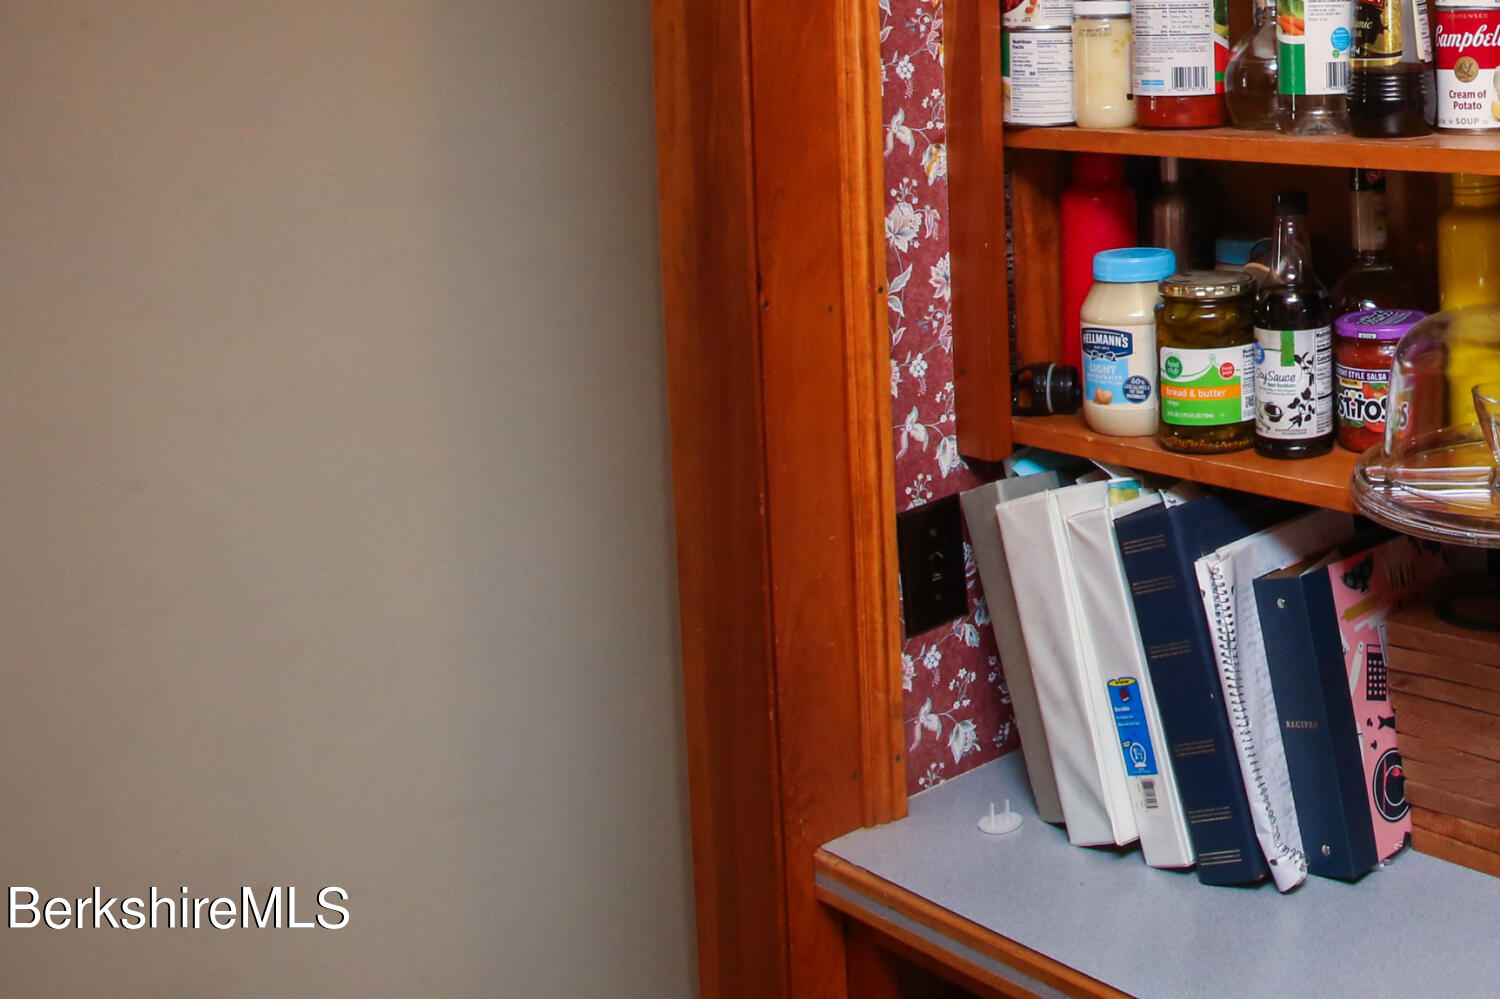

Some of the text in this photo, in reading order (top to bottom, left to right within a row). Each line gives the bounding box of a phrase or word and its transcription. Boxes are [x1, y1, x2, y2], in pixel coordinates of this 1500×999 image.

[1449, 89, 1487, 100] Cream of
[1453, 101, 1482, 111] Potato
[1267, 370, 1296, 382] Sauce
[1348, 370, 1365, 380] STYLE
[1366, 373, 1387, 381] SALSA
[1166, 387, 1226, 397] bread & butter
